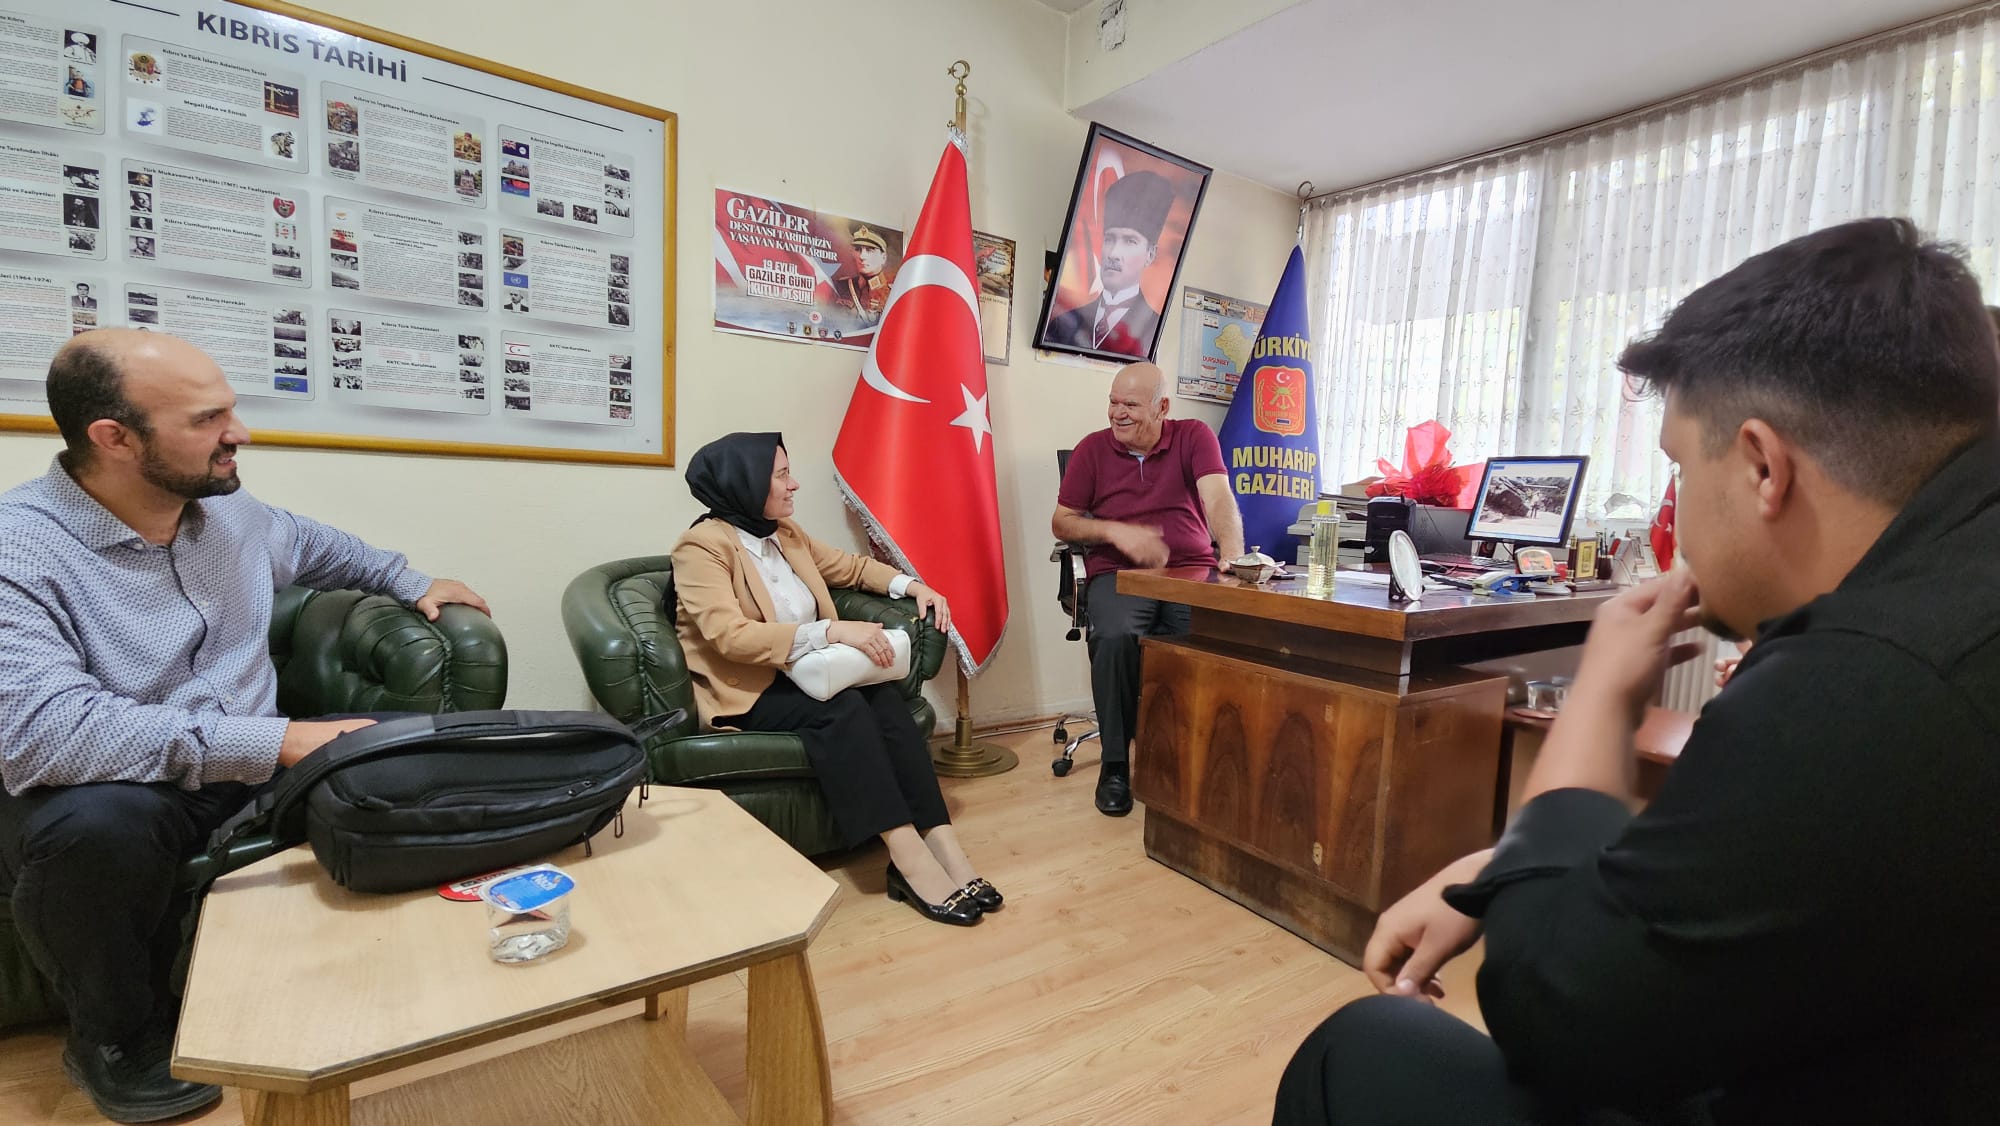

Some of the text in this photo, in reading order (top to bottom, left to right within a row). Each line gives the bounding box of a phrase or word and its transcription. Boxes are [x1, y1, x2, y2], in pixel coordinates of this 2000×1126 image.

[197, 11, 407, 83] KIBRIS TARİHİ
[726, 198, 809, 234] GAZİLER
[729, 220, 832, 249] DESTANSI TARİHİMİZİN
[729, 231, 838, 261] YAŞAYAN KANITLARIDIR
[749, 268, 813, 290] GAZİLER GÜNÜ
[763, 259, 798, 274] 19 EYLÜL
[750, 282, 811, 304] KUTLU OLSUN
[1248, 333, 1312, 363] ÜRKİY
[1232, 446, 1317, 474] MUHARİP
[1235, 468, 1315, 501] GAZİLERİ
